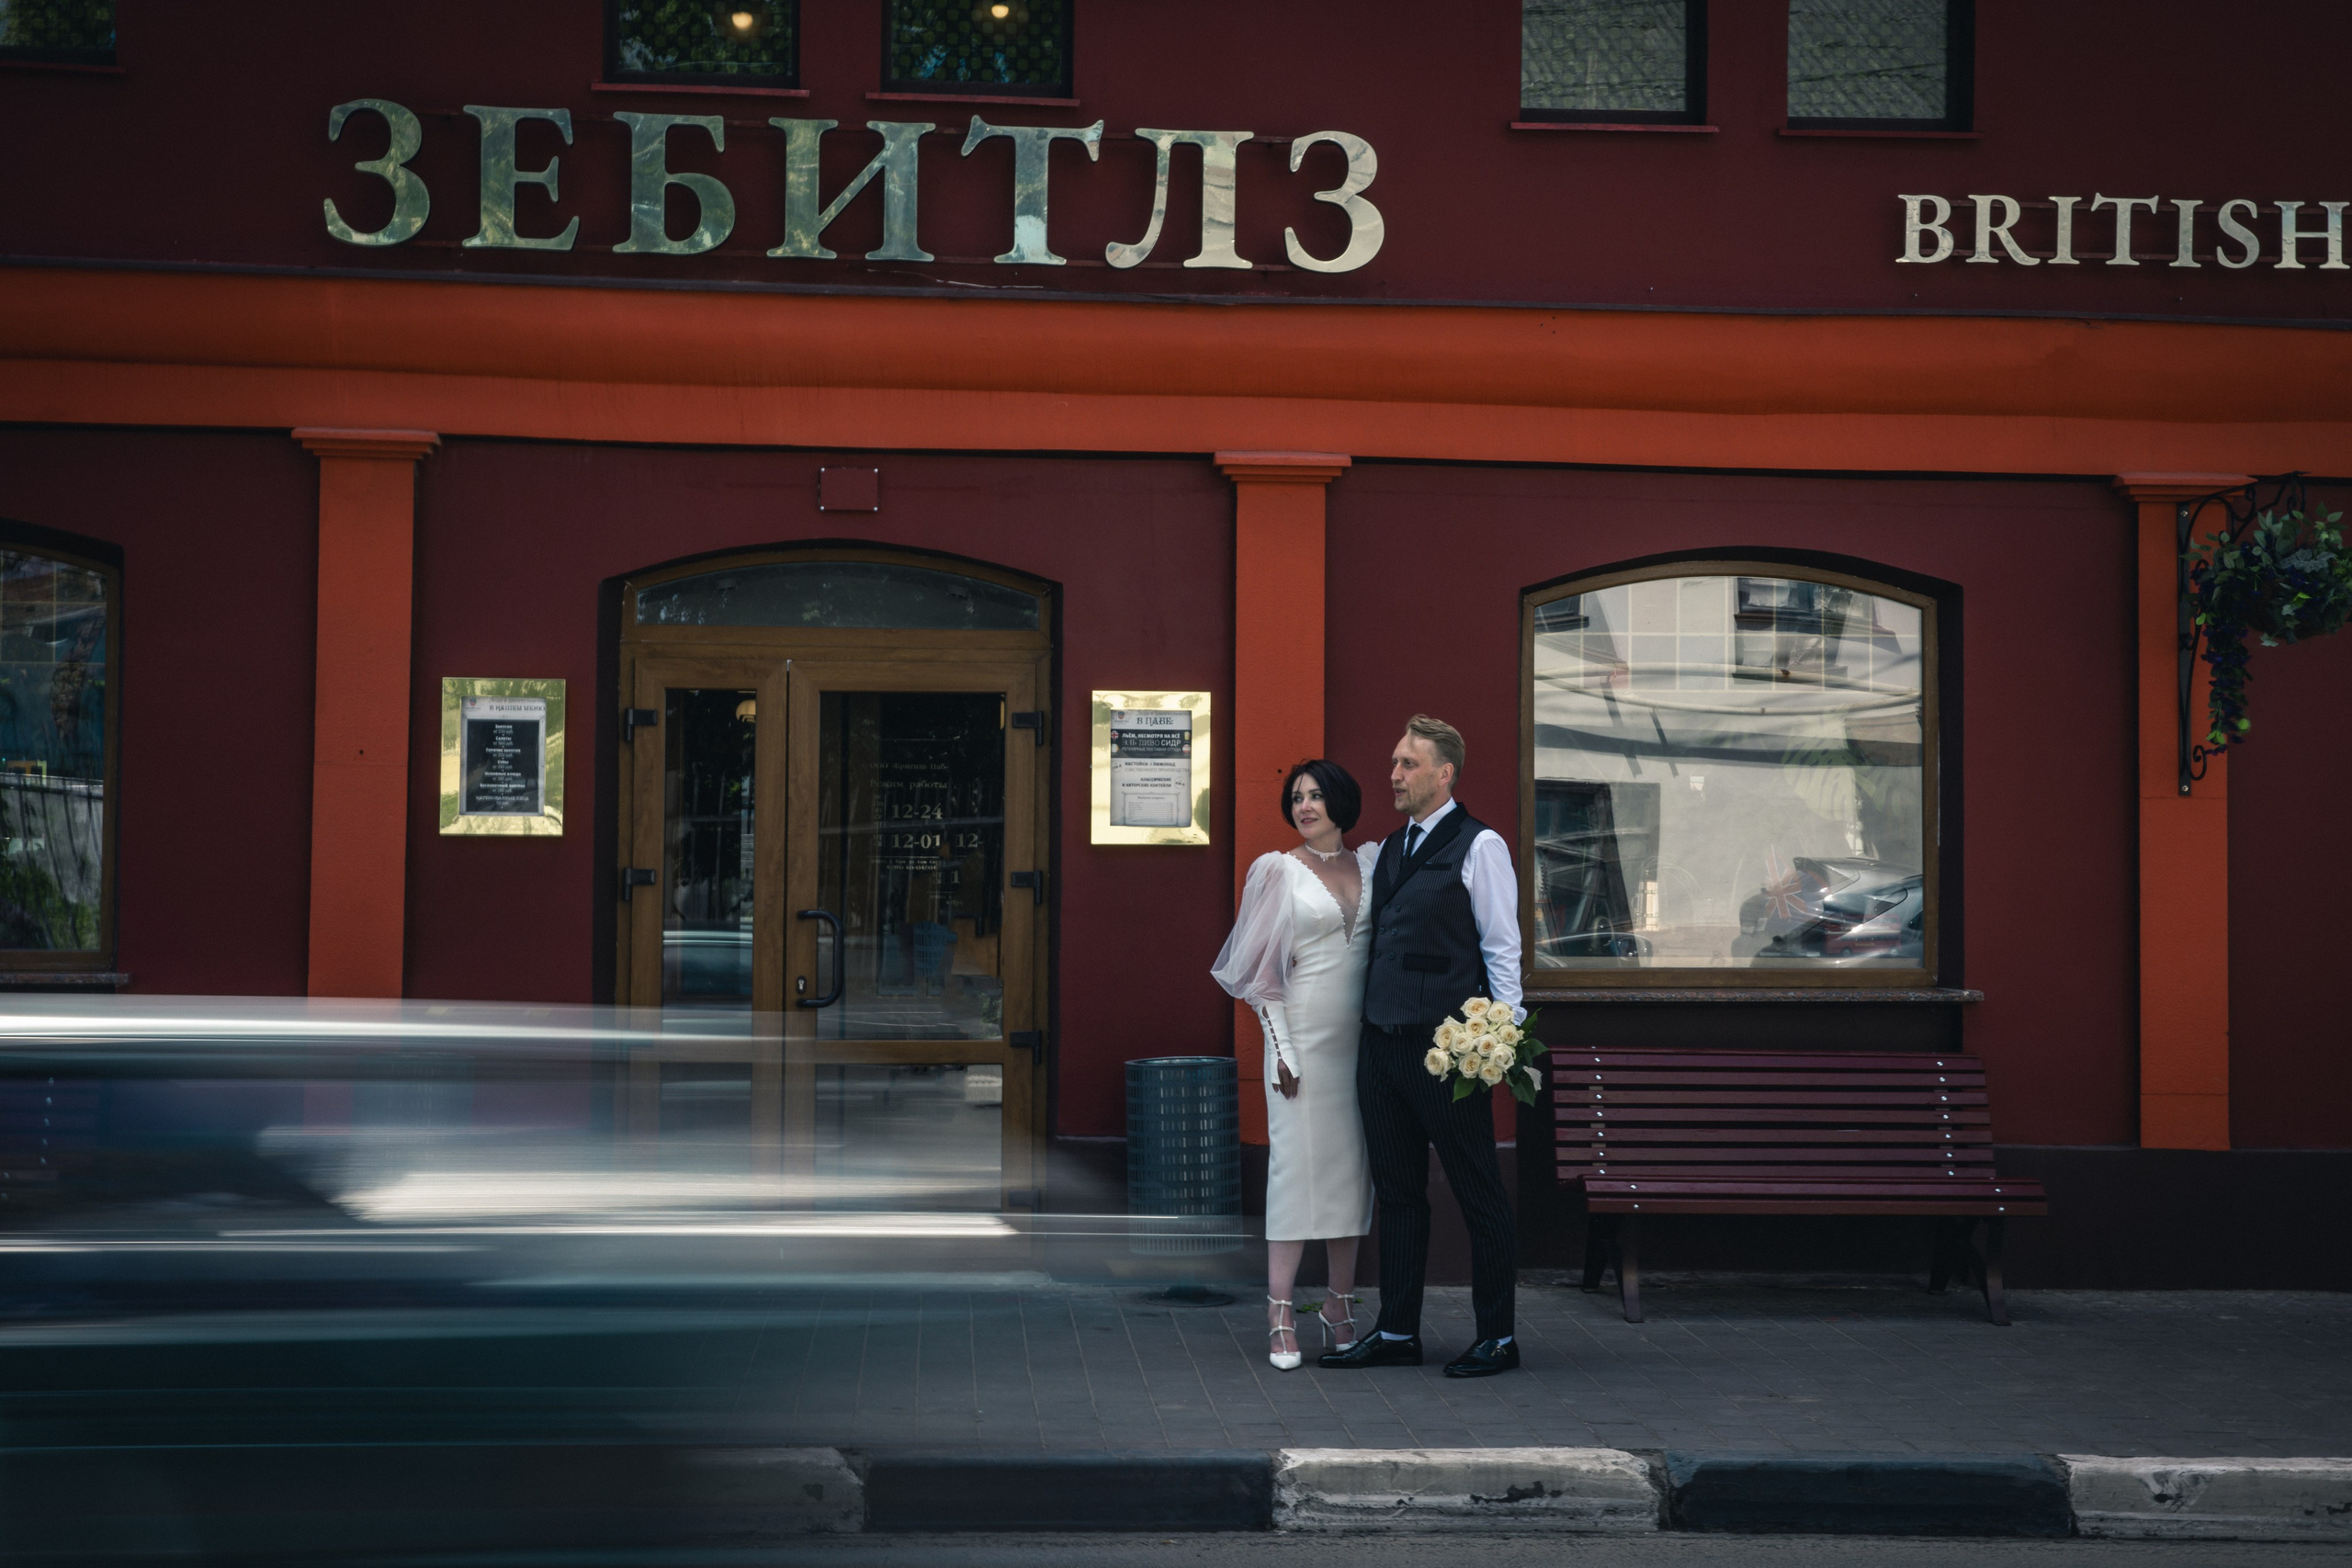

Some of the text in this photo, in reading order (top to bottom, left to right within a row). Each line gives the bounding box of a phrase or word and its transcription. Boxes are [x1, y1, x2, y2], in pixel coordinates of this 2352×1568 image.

[324, 98, 1385, 274] ЗЕБИТЛЗ
[1895, 192, 2351, 269] BRITISH
[1136, 716, 1143, 725] В
[909, 779, 948, 790] работы
[891, 802, 944, 820] 12-24
[891, 833, 942, 849] 12-01
